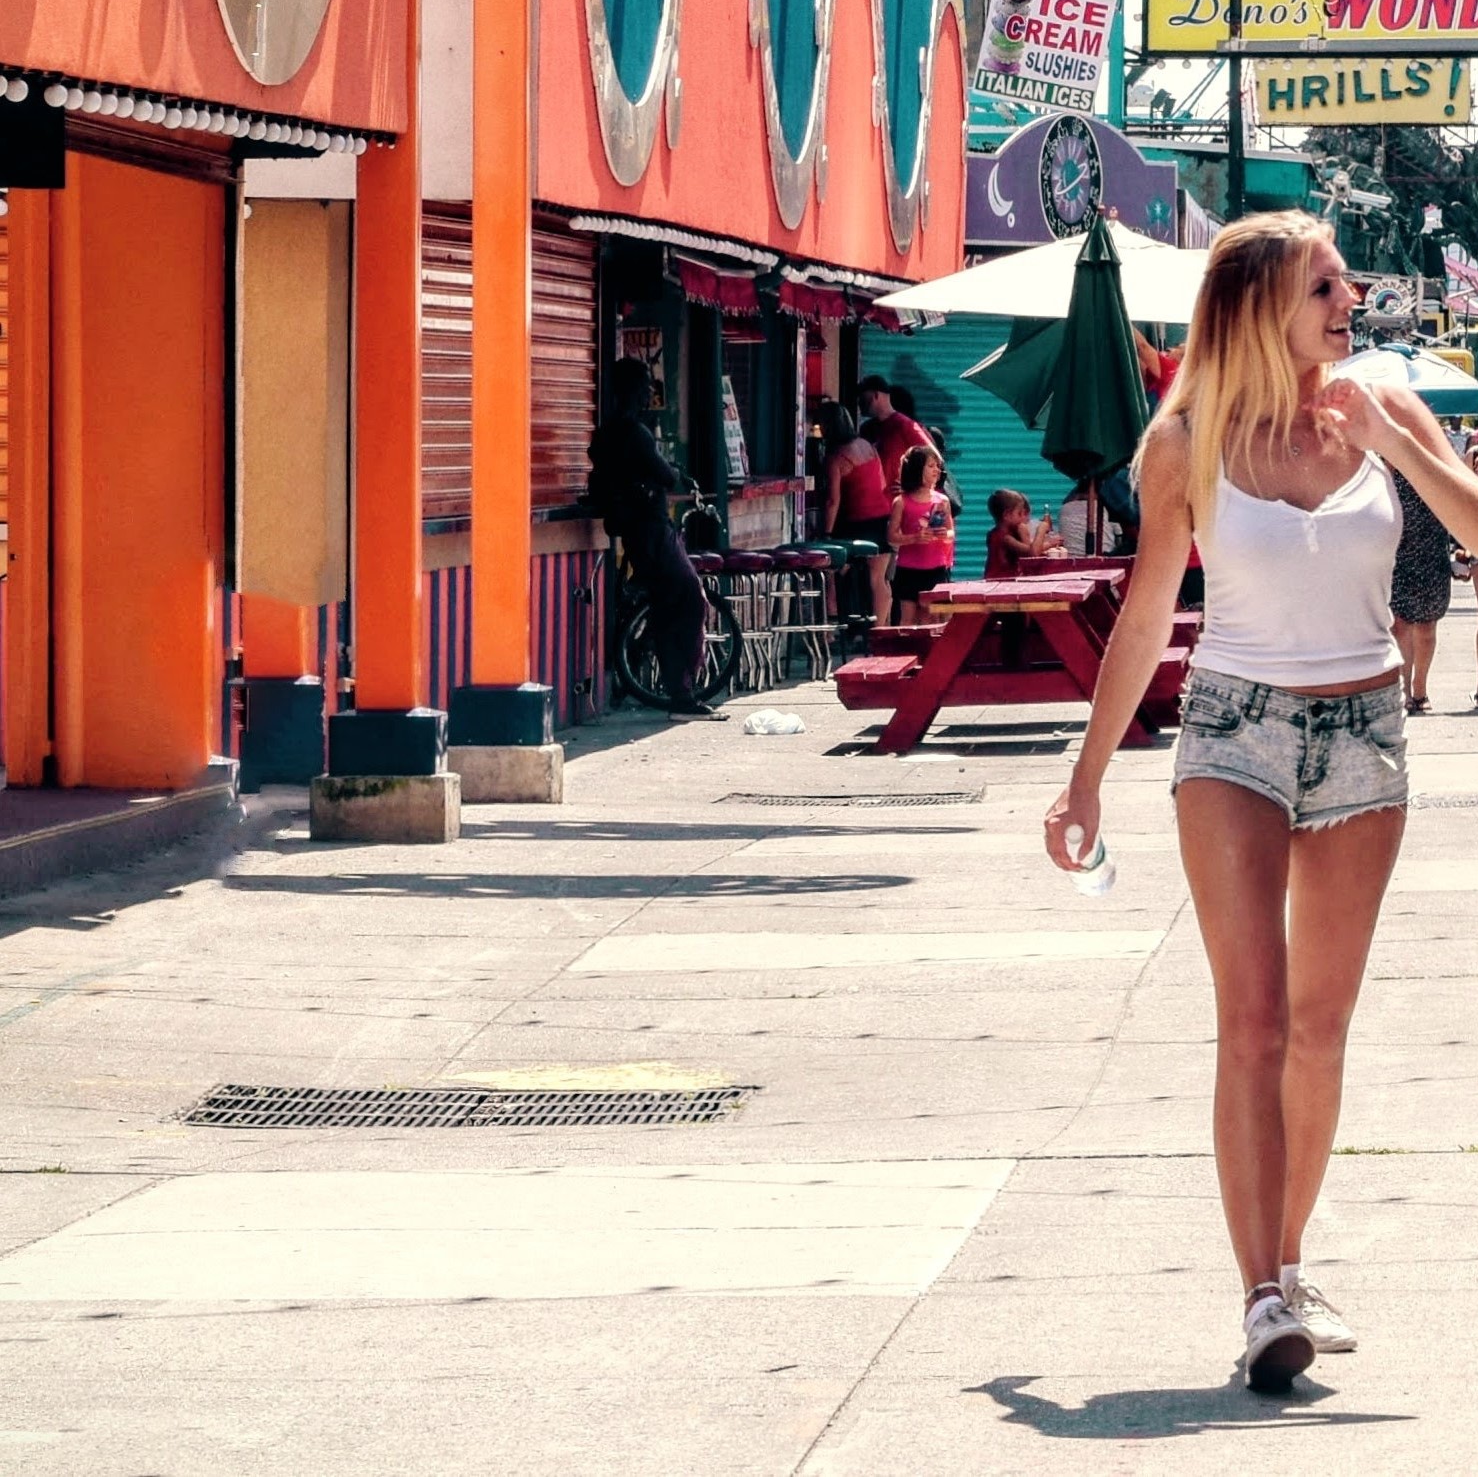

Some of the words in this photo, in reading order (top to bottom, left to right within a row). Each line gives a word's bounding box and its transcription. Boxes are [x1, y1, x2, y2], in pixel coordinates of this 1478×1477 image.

[1006, 14, 1103, 57] CREAM
[1025, 52, 1096, 81] SLUSHIES
[1256, 58, 1462, 116] HRILLS!
[978, 71, 1047, 102] ITALIAN
[1051, 88, 1092, 111] ICES
